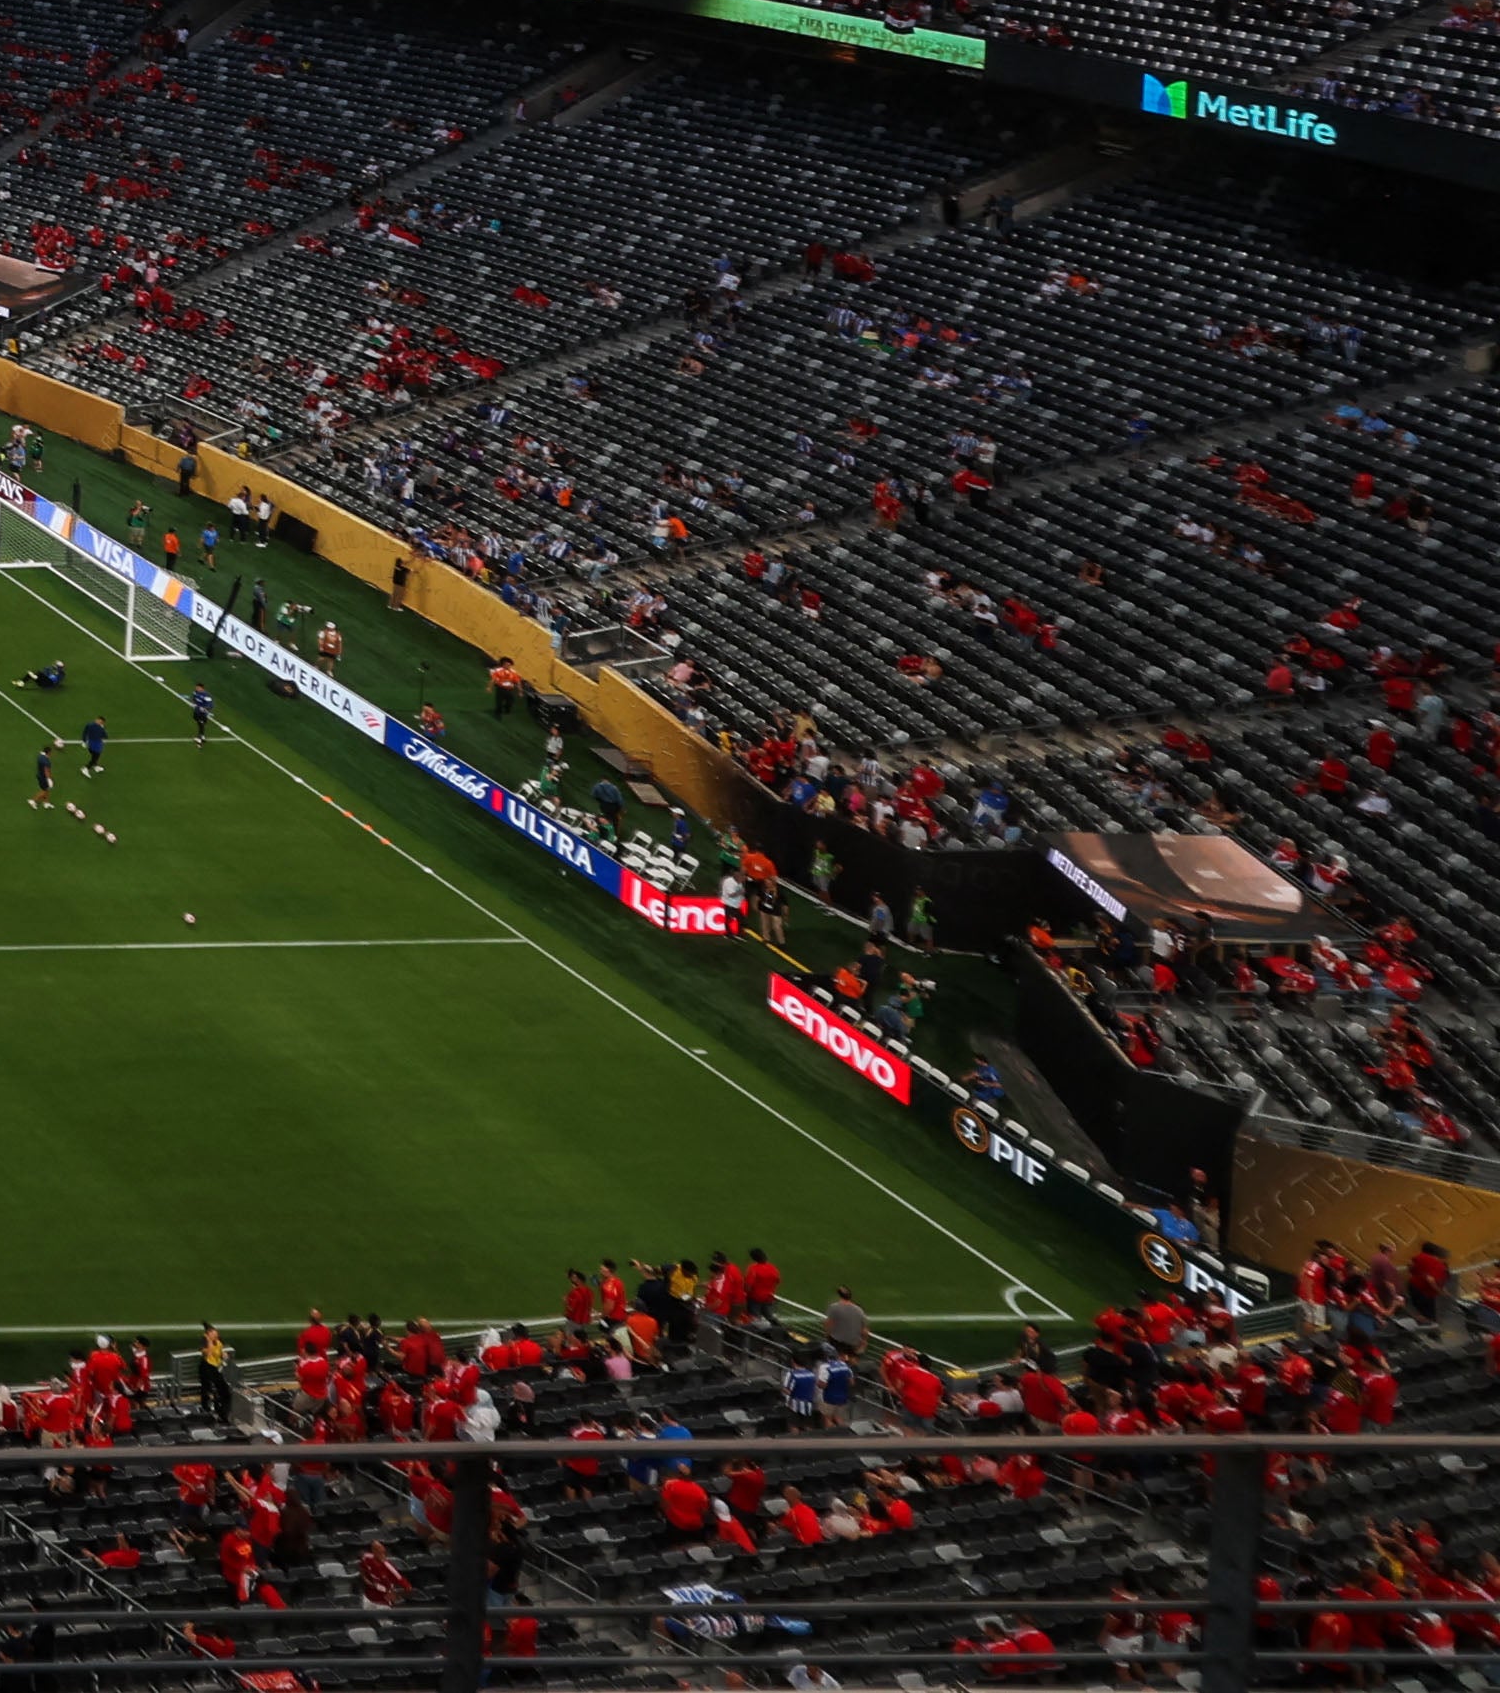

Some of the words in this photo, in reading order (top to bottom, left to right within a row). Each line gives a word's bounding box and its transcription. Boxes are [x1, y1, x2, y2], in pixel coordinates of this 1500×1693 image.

[798, 16, 823, 28] FIFA
[1194, 91, 1338, 146] MetLife
[88, 528, 136, 579] VISA
[245, 637, 266, 658] OF
[271, 653, 354, 717] AMERICA
[402, 736, 490, 800] Michelob
[506, 798, 597, 876] ULTRA
[767, 974, 896, 1090] Lenovo
[988, 1130, 1048, 1187] PIF
